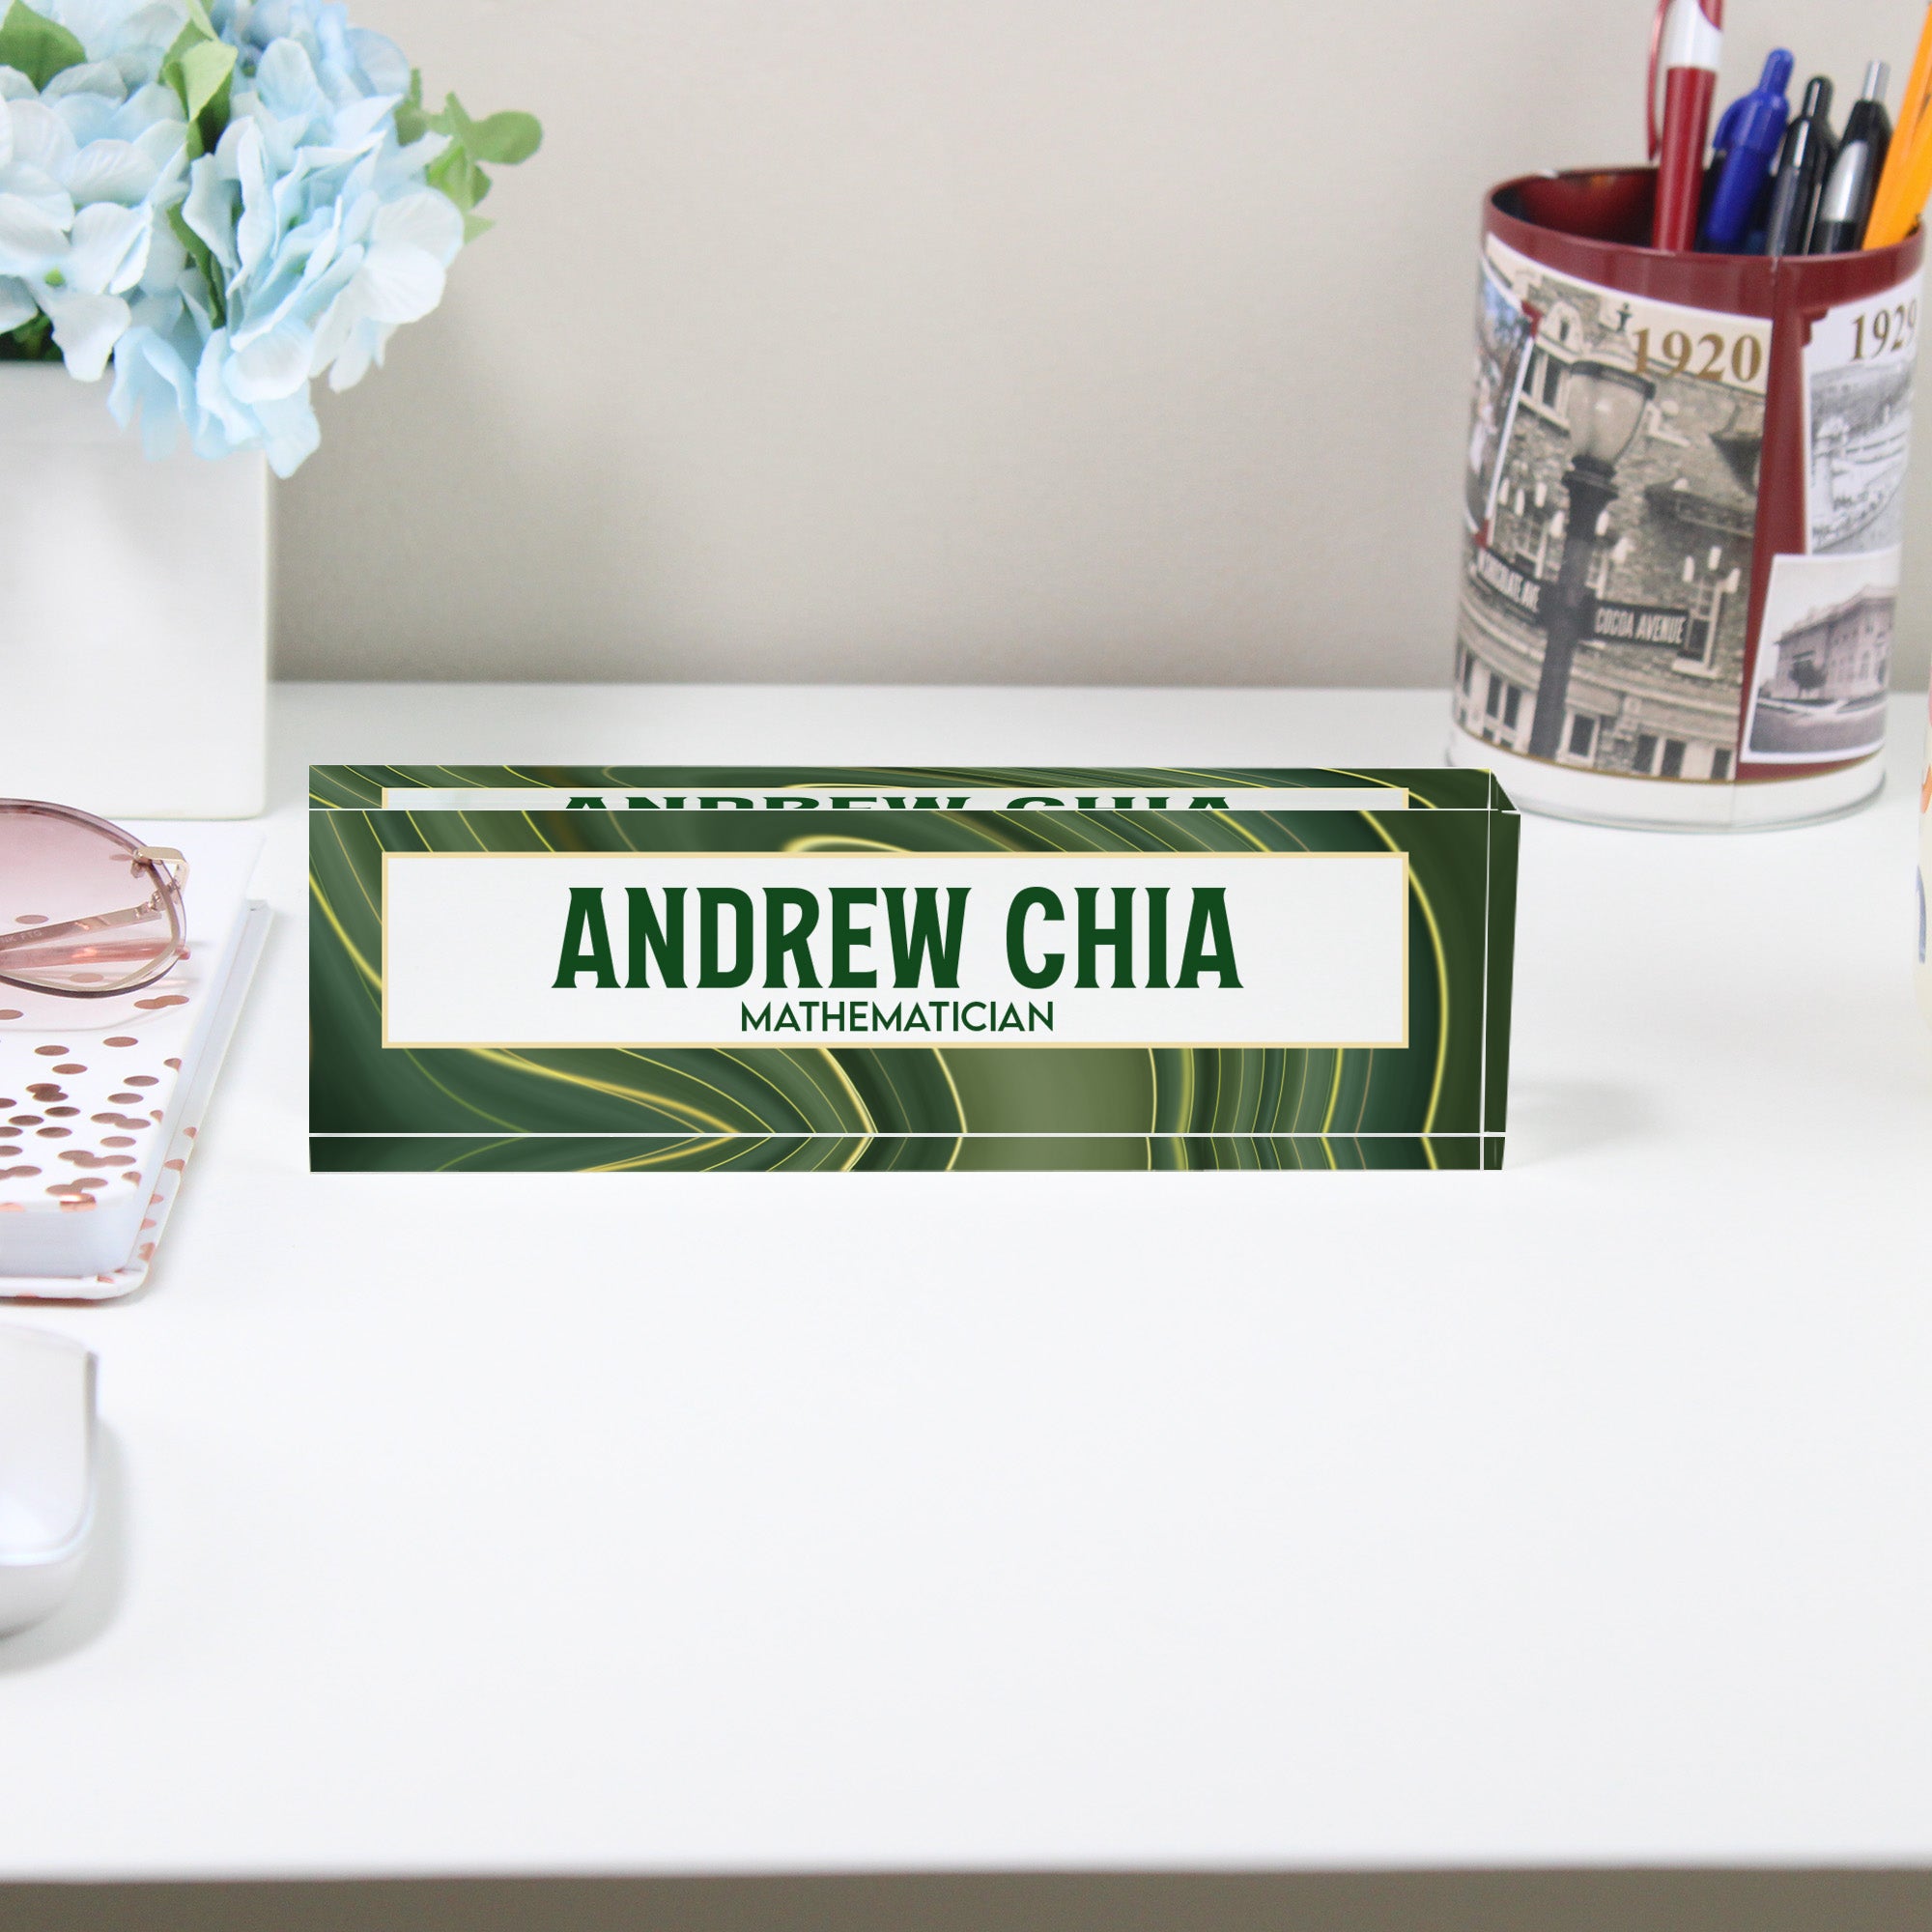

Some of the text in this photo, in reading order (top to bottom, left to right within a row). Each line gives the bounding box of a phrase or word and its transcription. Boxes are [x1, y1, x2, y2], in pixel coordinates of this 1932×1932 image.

[1633, 328, 1762, 382] 1920
[1594, 608, 1686, 644] COCOA AVENUE
[552, 887, 1243, 989] ANDREW CHIA
[742, 1002, 1053, 1031] MATHEMATICIAN
